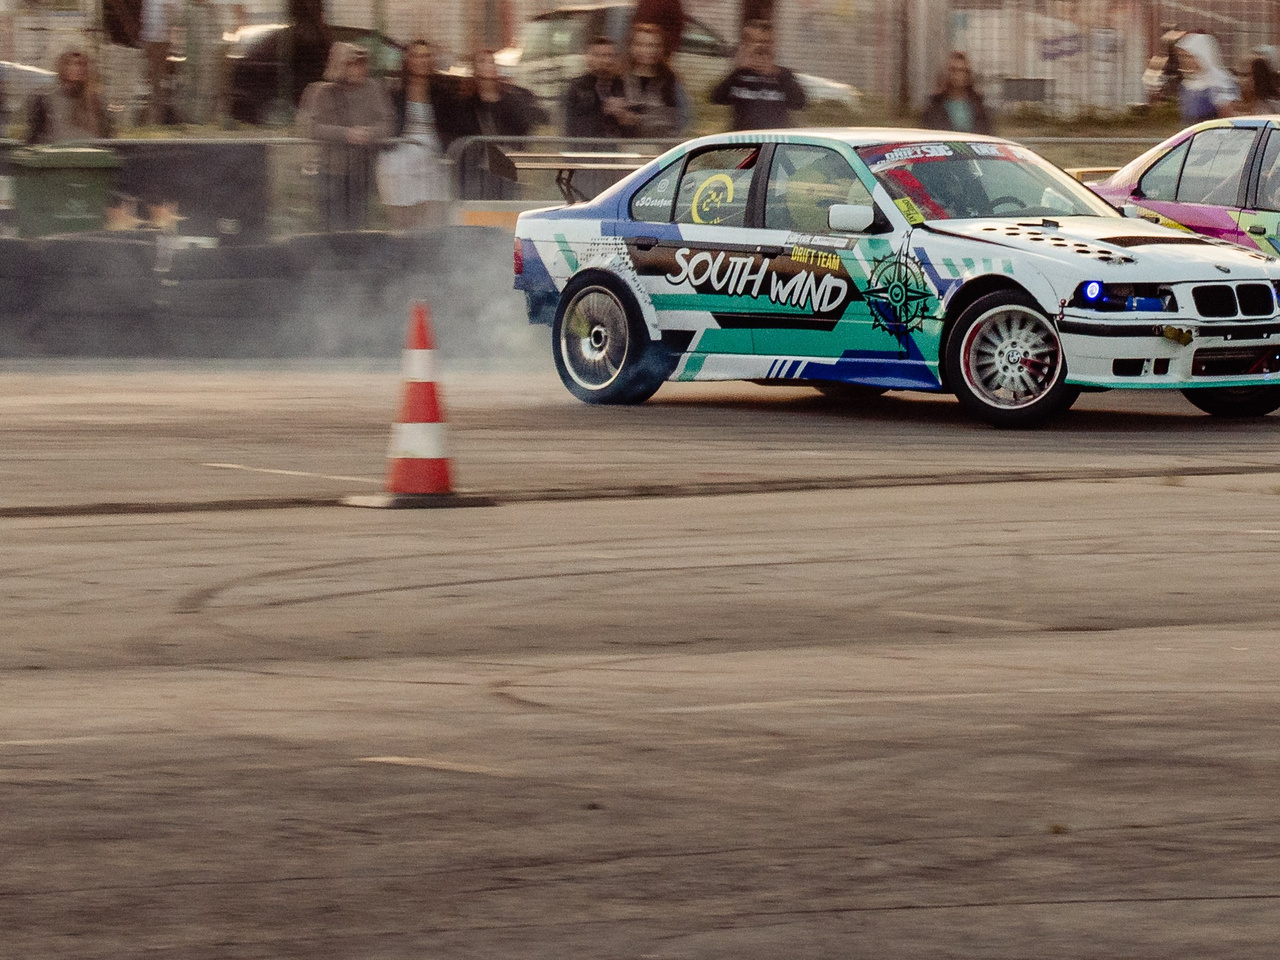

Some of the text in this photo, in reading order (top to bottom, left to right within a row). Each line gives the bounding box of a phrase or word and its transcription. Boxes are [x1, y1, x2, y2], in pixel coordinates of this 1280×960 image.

[666, 247, 848, 313] SOUTH WIND
[790, 244, 840, 272] DRIFT TEAM
